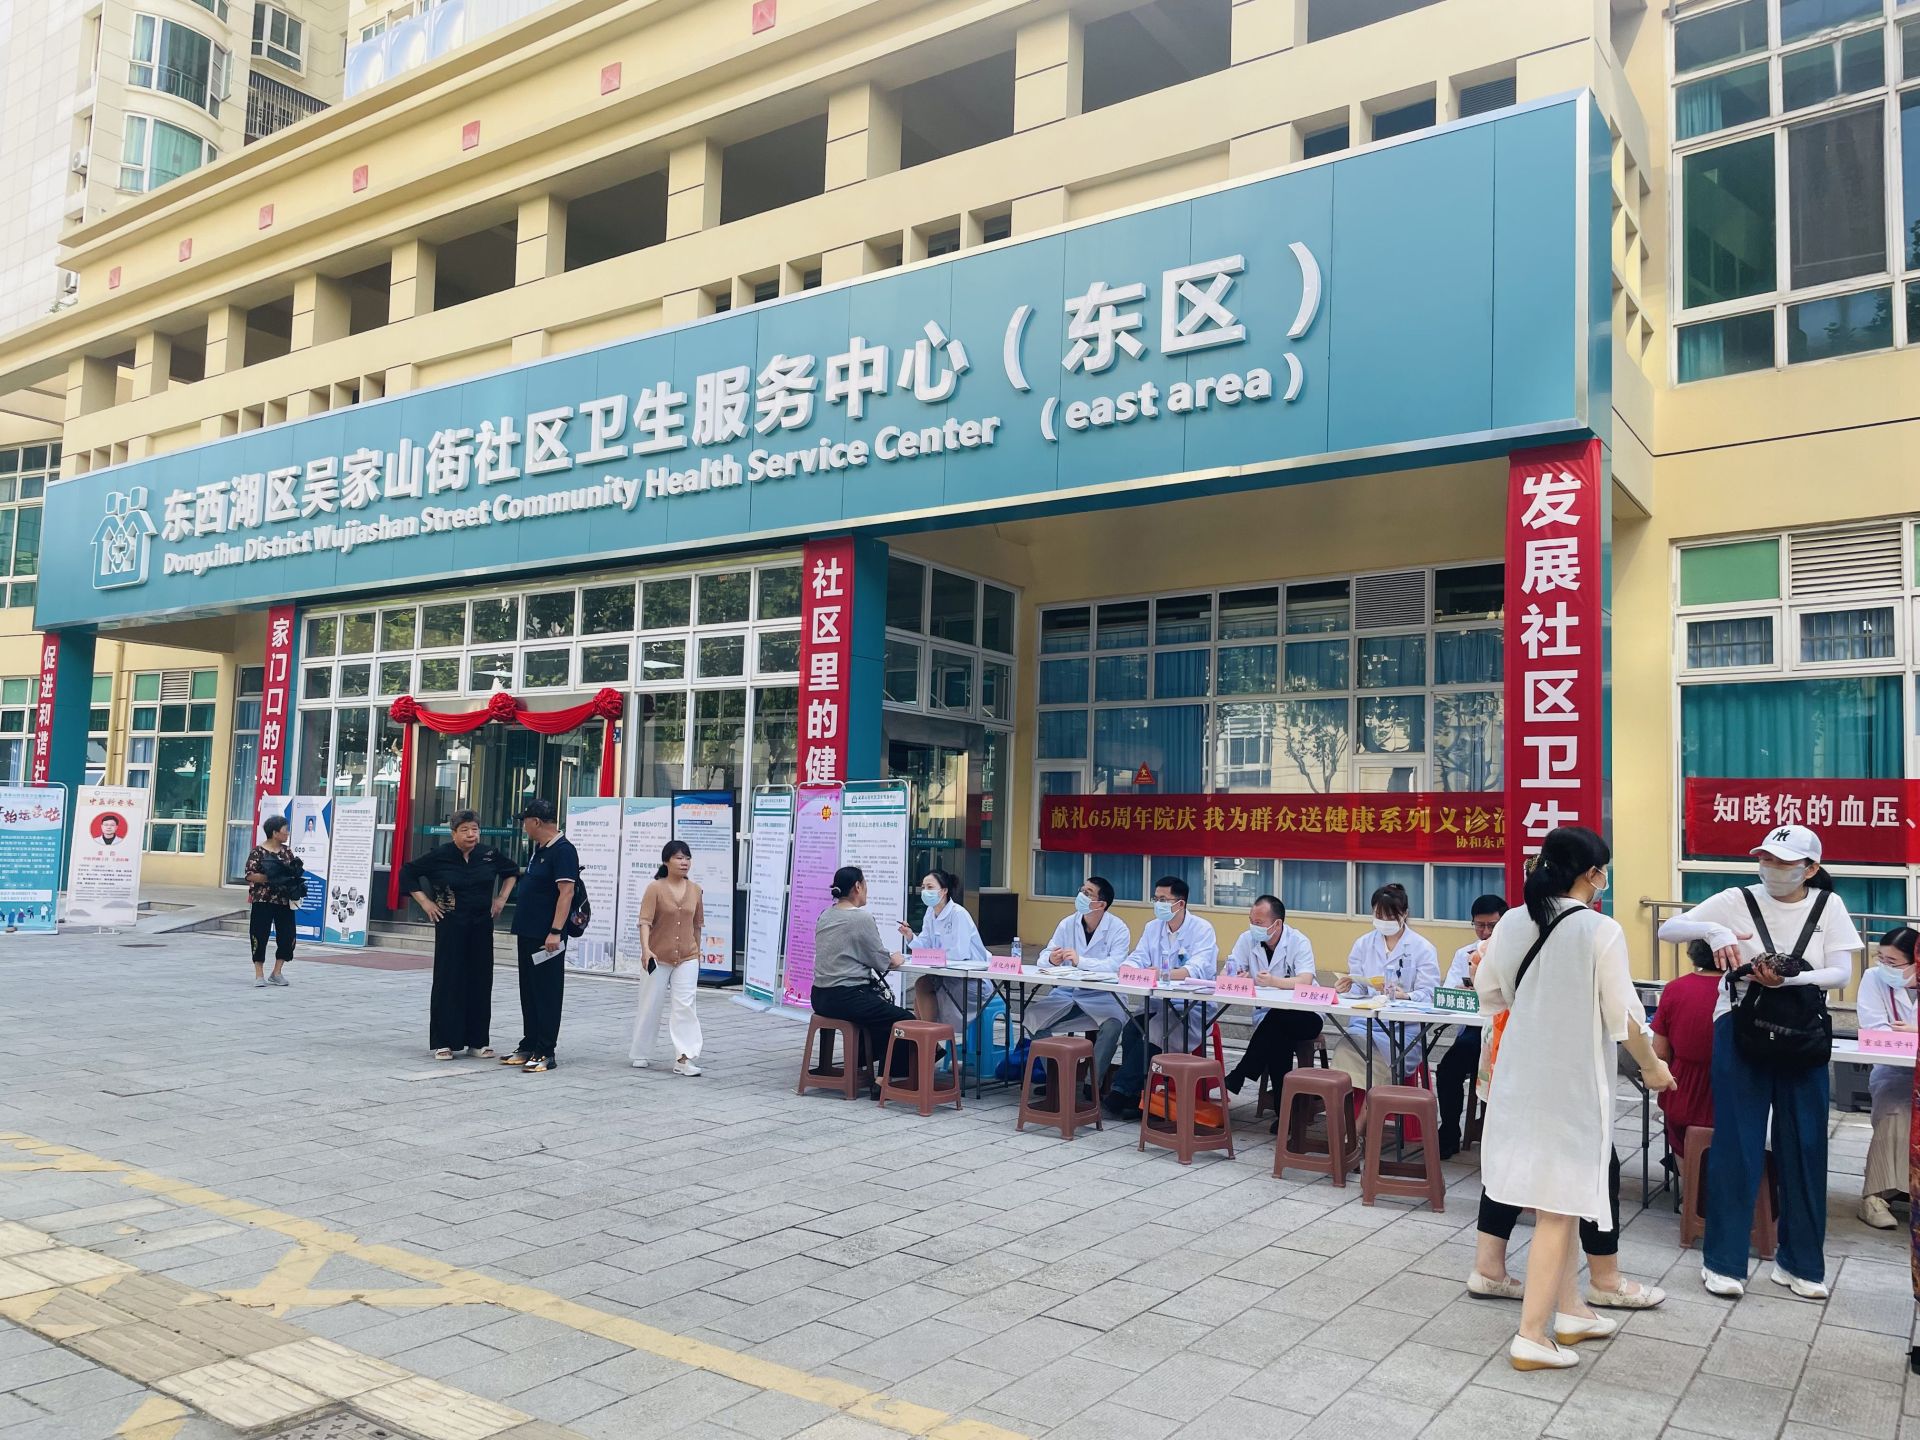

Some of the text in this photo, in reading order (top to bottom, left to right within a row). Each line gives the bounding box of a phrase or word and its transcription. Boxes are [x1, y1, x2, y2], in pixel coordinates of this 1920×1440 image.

[163, 543, 244, 576] Dongxihu
[244, 529, 314, 562] District
[313, 514, 420, 553] Wujiashan
[420, 499, 492, 534] Street
[492, 475, 641, 522] Community
[645, 454, 743, 499] Health
[747, 437, 870, 483] Service
[874, 416, 1001, 461] Center
[805, 557, 844, 787] 社区里的健
[34, 645, 57, 785] 促进和谐社
[1051, 806, 1198, 831] 献礼65周年院庆
[1218, 983, 1249, 992] 泌尿外科
[1300, 991, 1329, 1001] 口腔科
[1436, 993, 1476, 1010] 静脉曲张
